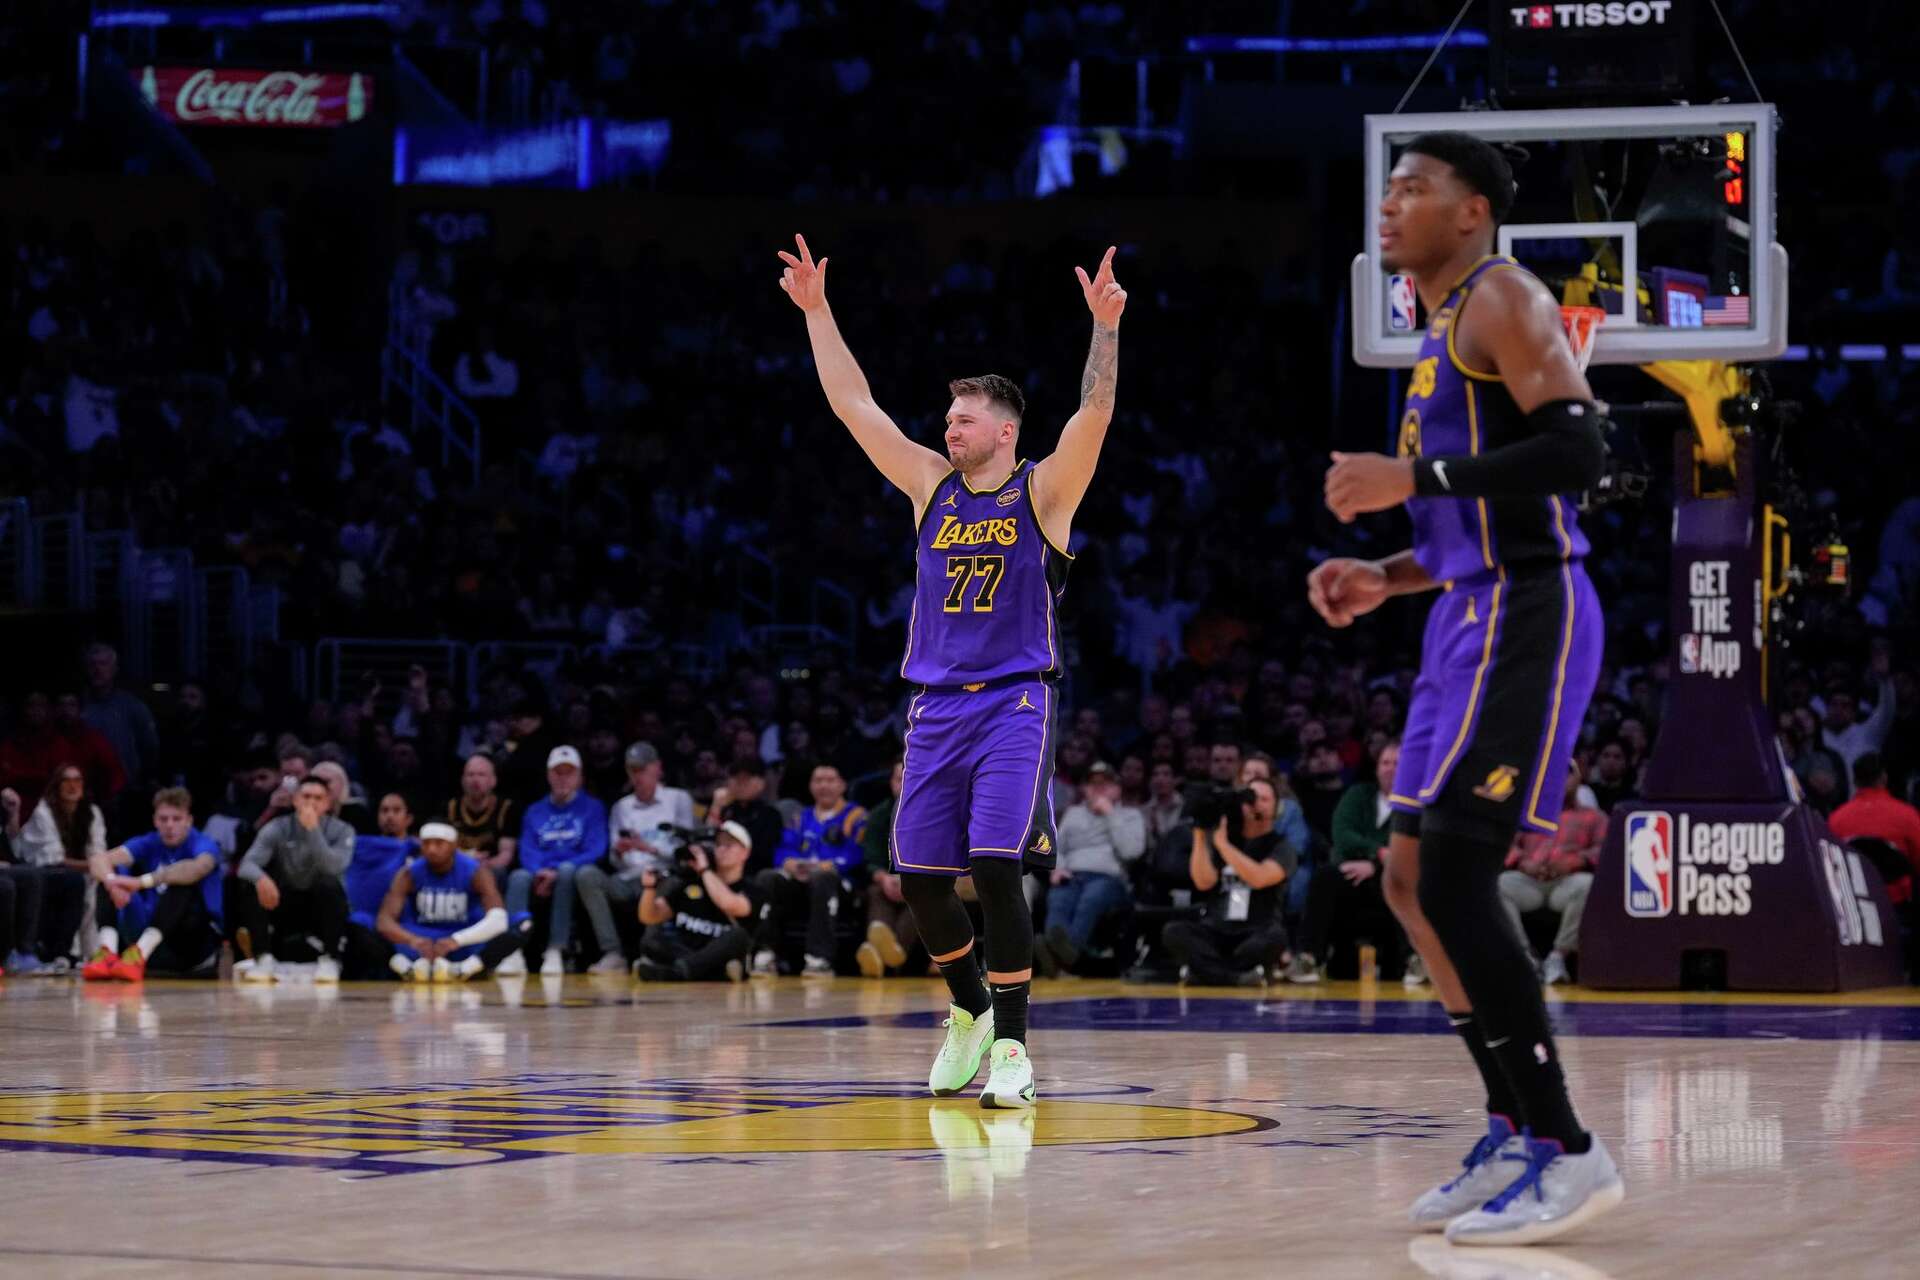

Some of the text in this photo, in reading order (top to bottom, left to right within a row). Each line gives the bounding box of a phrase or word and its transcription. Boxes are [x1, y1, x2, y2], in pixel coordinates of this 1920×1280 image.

[1554, 1, 1672, 27] TISSOT
[175, 69, 325, 123] Coca-Cola
[930, 515, 1018, 549] LAKERS
[943, 555, 1004, 612] 77
[1690, 561, 1730, 597] GET
[1689, 597, 1731, 634] THE
[1700, 634, 1741, 679] App
[1678, 813, 1785, 873] League
[1678, 865, 1752, 915] Pass
